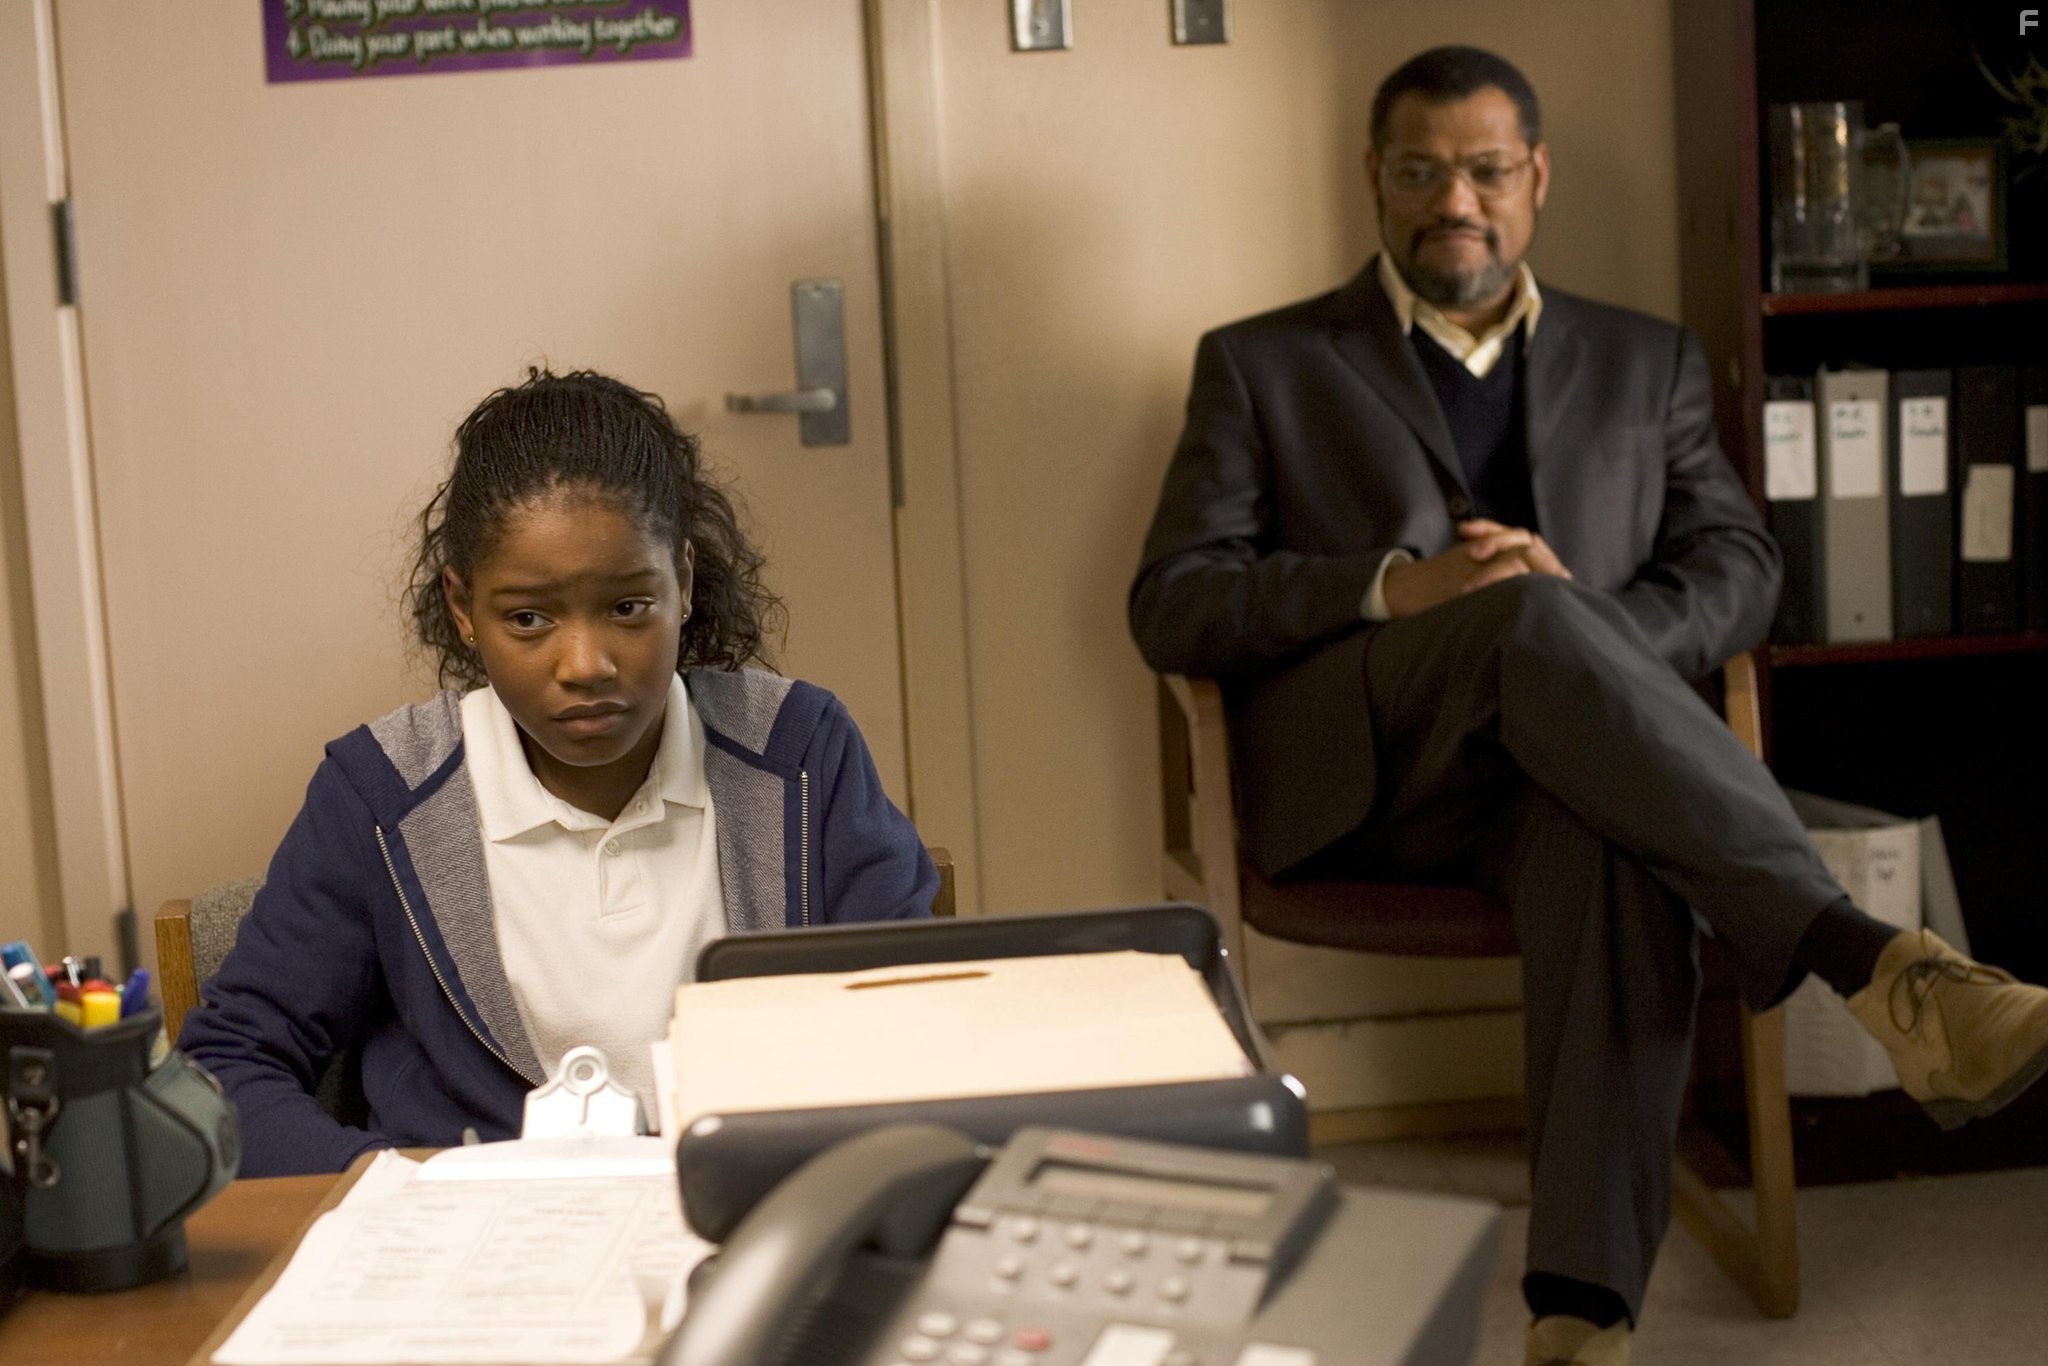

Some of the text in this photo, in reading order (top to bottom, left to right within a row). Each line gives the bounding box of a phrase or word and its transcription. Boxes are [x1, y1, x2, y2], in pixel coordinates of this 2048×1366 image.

[307, 24, 363, 68] Doing
[365, 32, 411, 61] your
[413, 23, 457, 60] part
[459, 16, 514, 48] when
[515, 14, 592, 54] working
[594, 8, 680, 51] together
